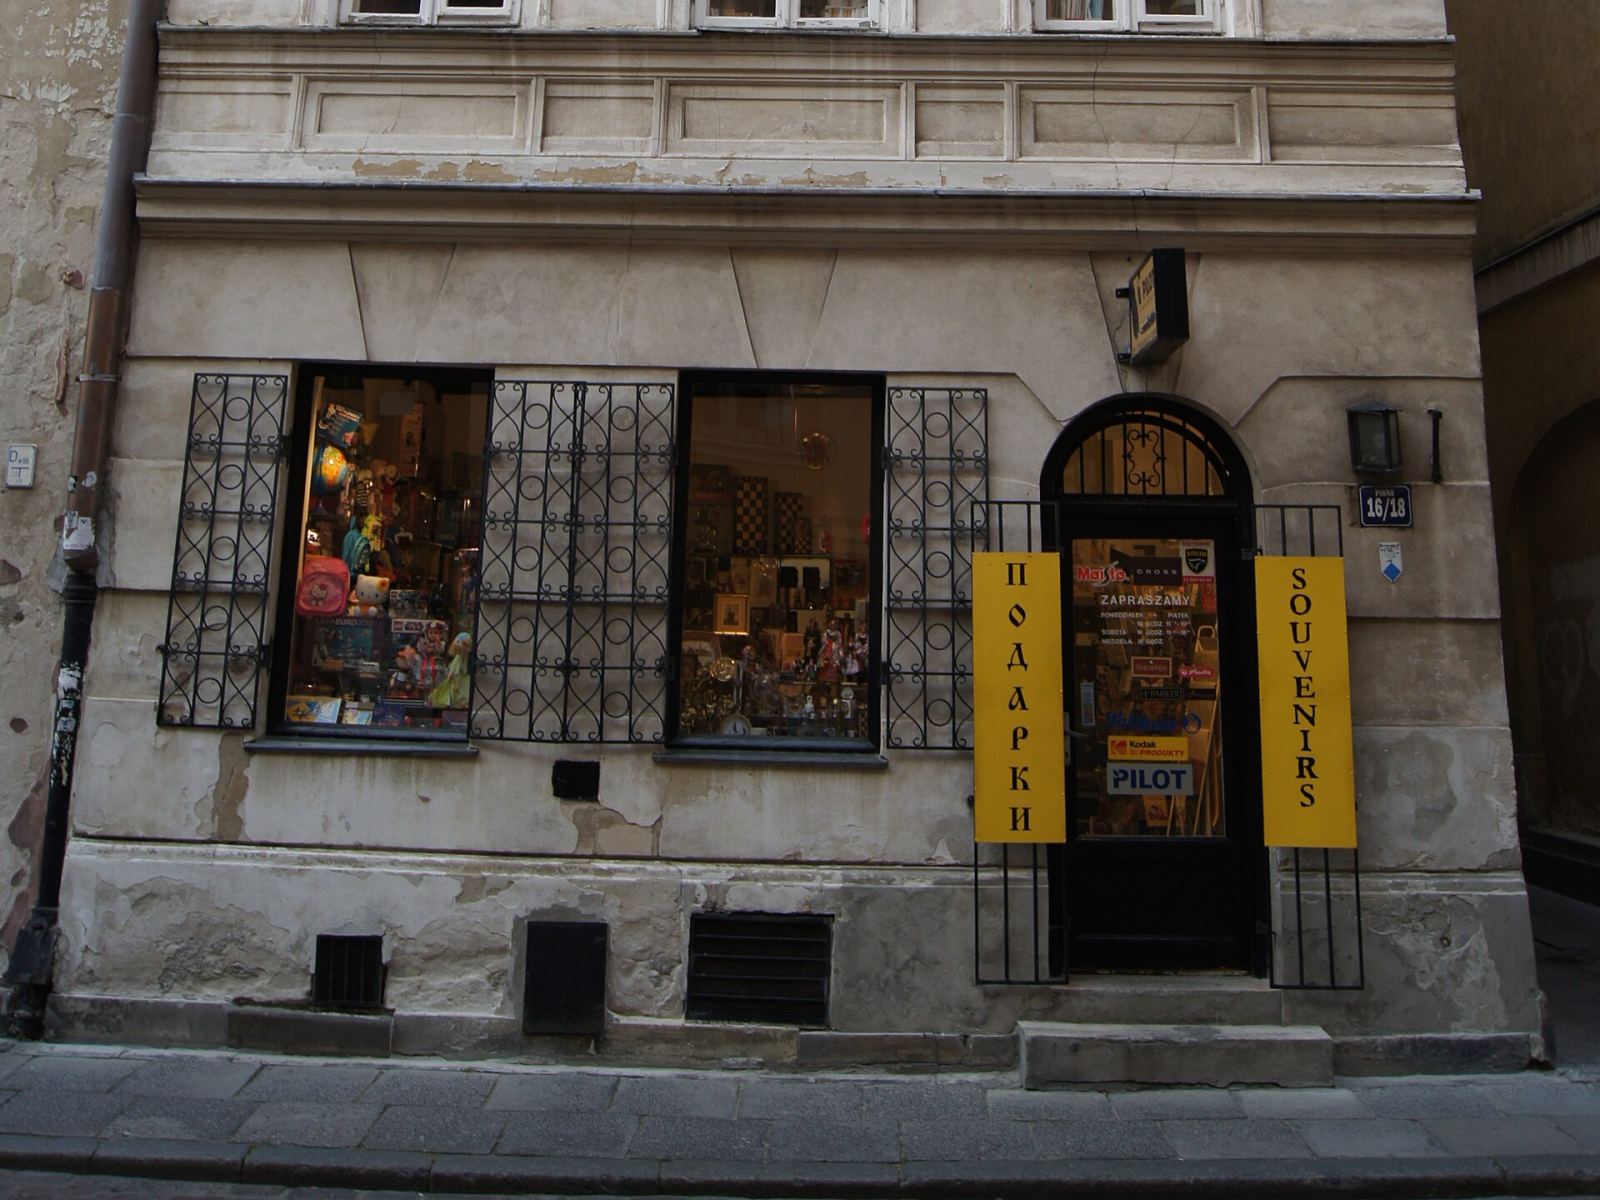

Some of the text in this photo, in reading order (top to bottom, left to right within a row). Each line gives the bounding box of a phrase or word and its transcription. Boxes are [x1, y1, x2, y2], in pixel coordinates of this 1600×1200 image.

[1367, 497, 1406, 521] 16/18
[1136, 568, 1178, 576] CROSS
[1100, 594, 1190, 606] ZAPRASZAMY
[1150, 688, 1181, 698] PARKER
[1289, 567, 1319, 808] SOUVENIRS
[1006, 562, 1032, 832] ПОДАРКИ
[1129, 740, 1157, 748] Kodak
[1113, 769, 1187, 790] PILOT
